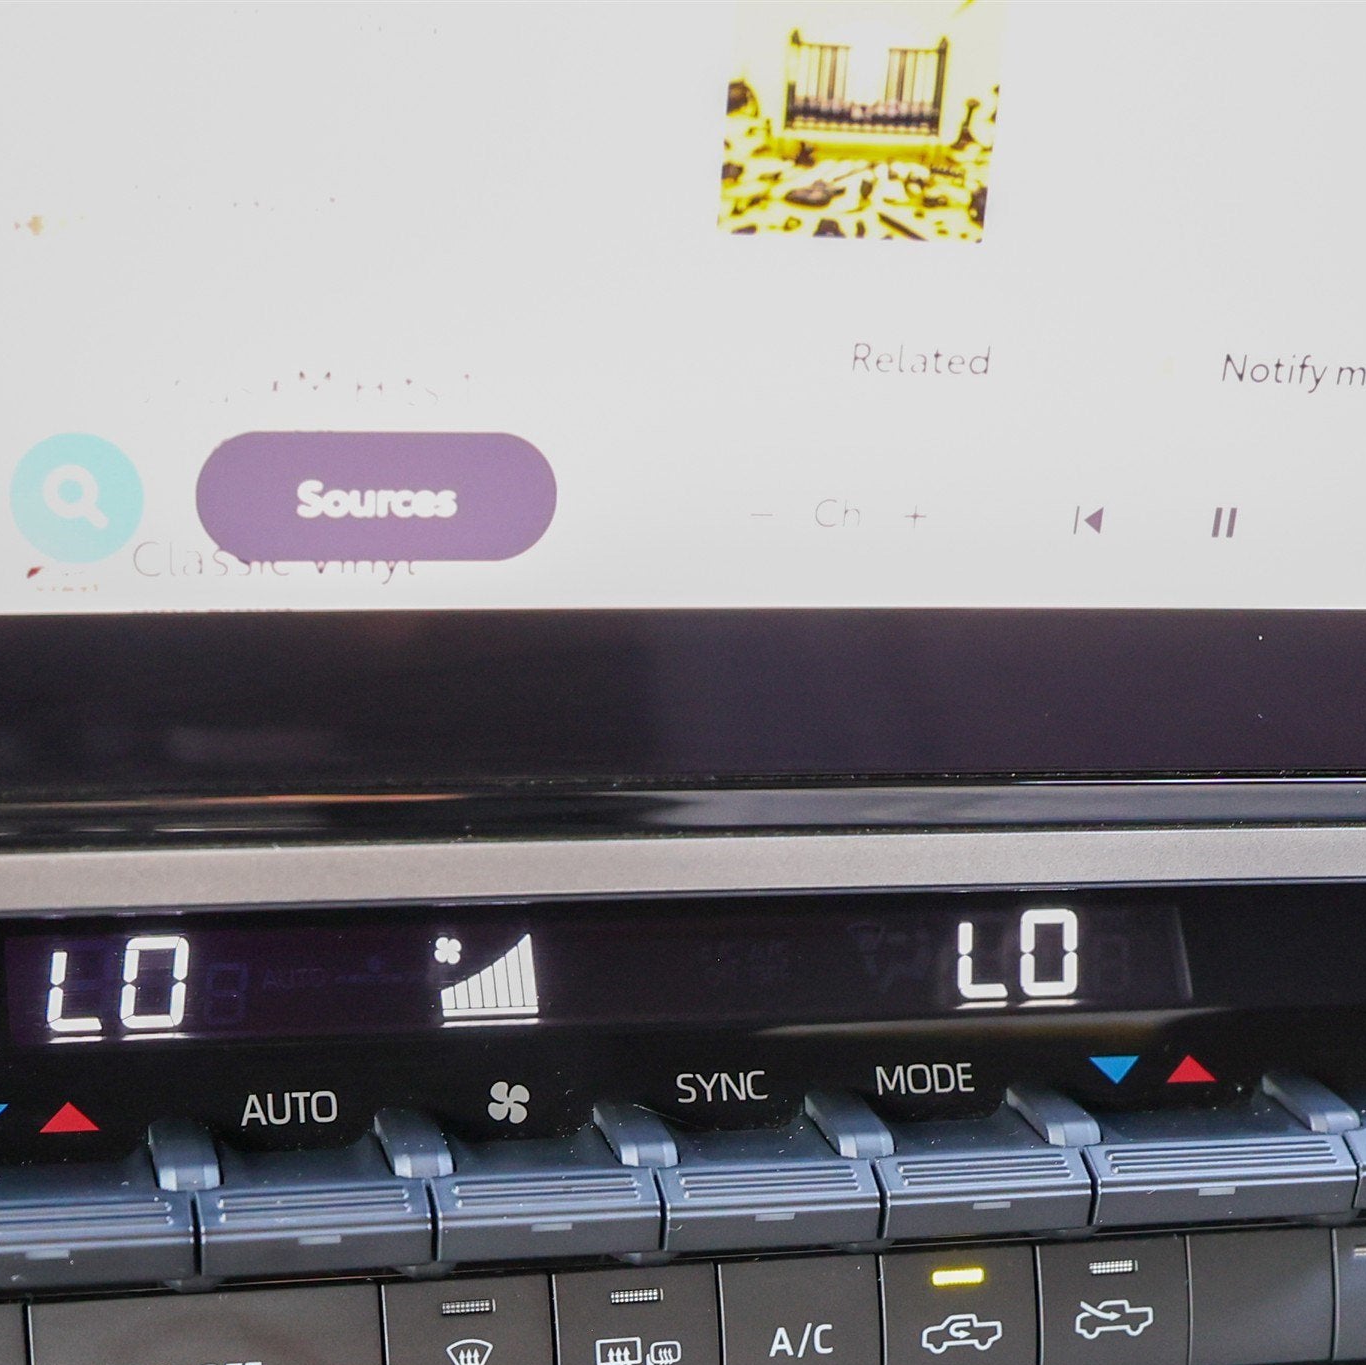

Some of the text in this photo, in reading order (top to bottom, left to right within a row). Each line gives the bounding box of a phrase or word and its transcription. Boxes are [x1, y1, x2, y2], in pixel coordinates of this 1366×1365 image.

[851, 343, 992, 376] Related
[1221, 354, 1328, 394] Notify
[296, 480, 458, 518] Sources
[957, 908, 1078, 999] LO
[47, 935, 189, 1032] LO
[674, 1070, 769, 1103] SYNC
[875, 1062, 975, 1095] MODE
[240, 1089, 338, 1126] AUTO
[769, 1322, 833, 1358] A/C
